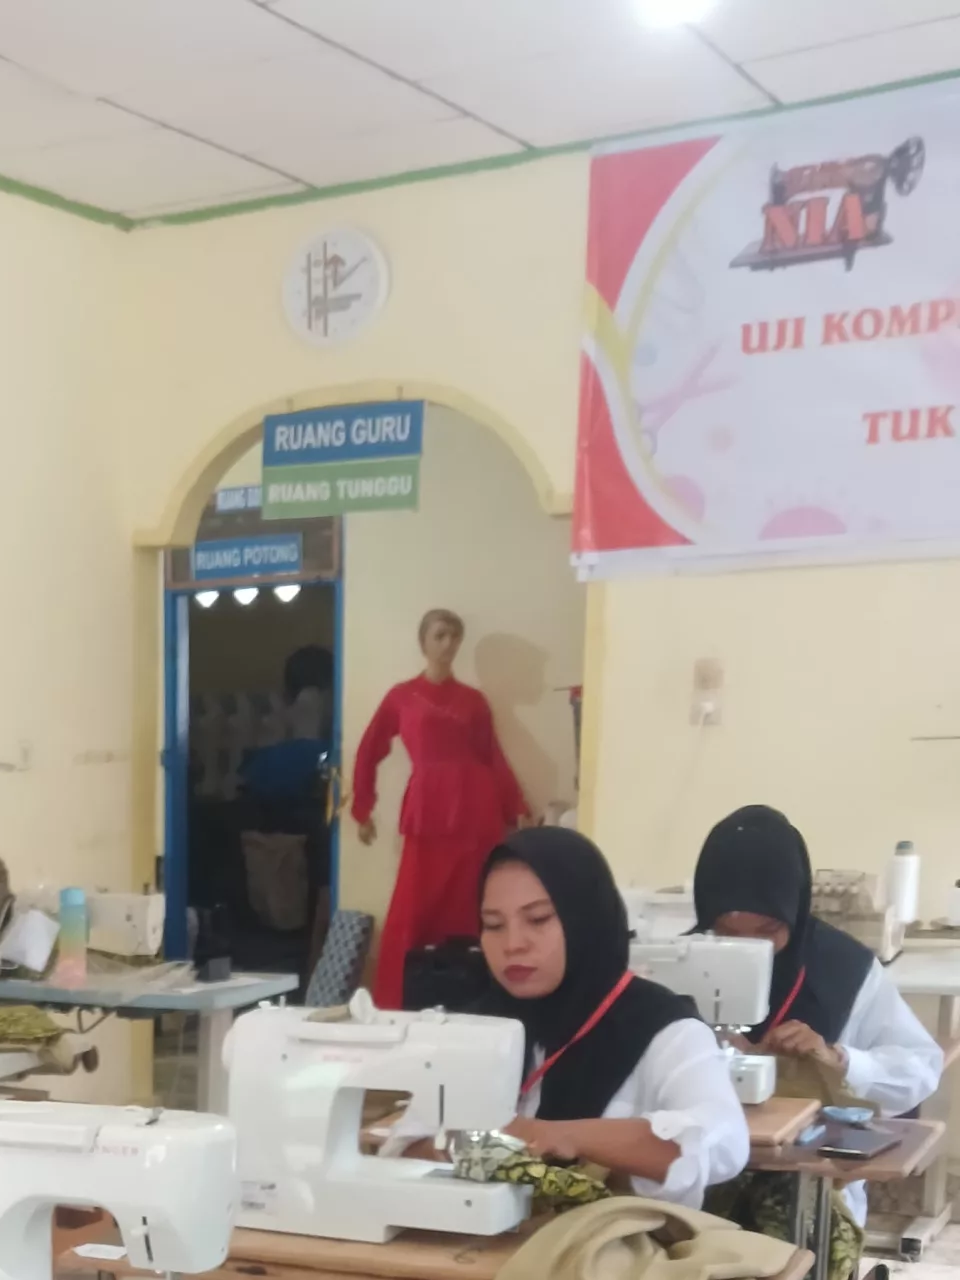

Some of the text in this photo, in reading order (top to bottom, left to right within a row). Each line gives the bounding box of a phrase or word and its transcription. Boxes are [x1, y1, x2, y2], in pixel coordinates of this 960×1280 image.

[740, 297, 960, 355] UJI KOMP
[274, 414, 412, 452] RUANG GURU
[862, 404, 956, 445] TUK
[267, 480, 330, 505] RUANG
[336, 474, 414, 500] TUNGGU
[195, 542, 299, 571] RUANG POTONG
